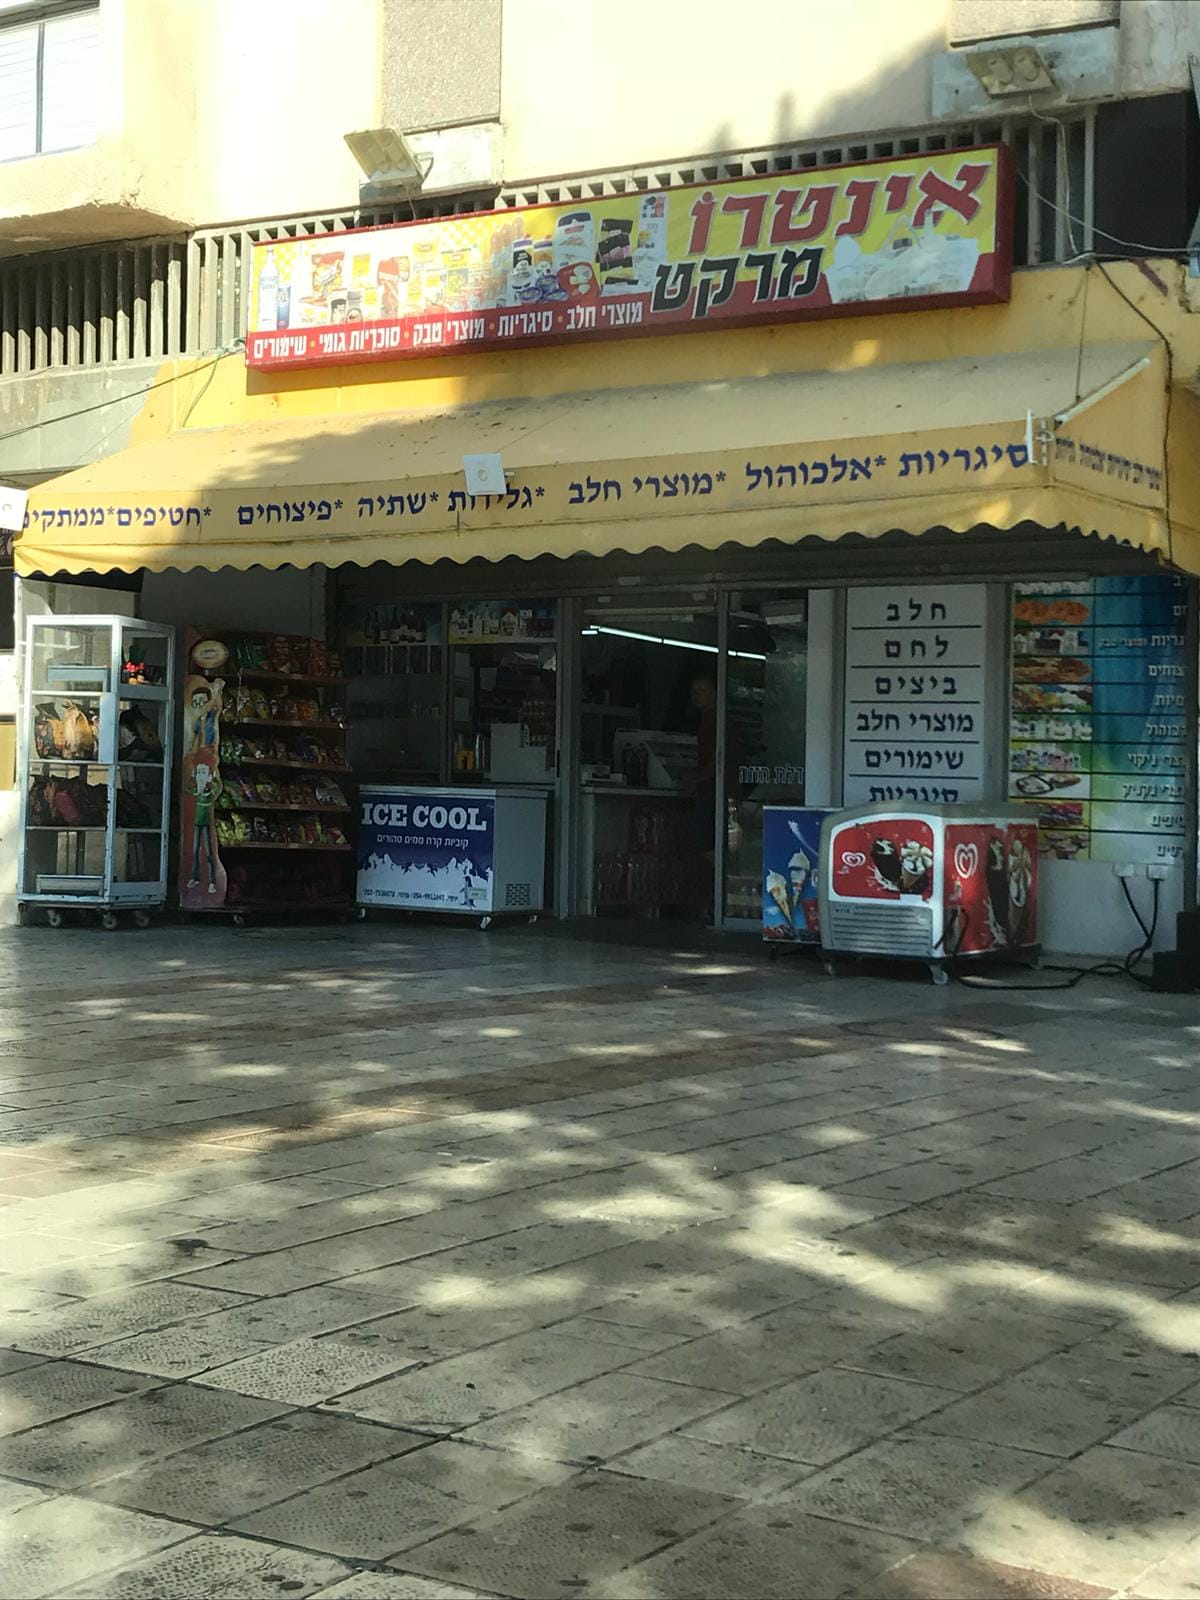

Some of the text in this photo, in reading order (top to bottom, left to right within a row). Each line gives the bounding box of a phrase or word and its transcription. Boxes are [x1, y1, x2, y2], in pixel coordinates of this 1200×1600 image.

[689, 163, 992, 255] אינטרו
[651, 246, 825, 319] מרקט
[254, 301, 643, 358] מוצרי חלב סיגריות מוצרי טבק סוכריות גומי שימורים
[632, 470, 712, 499] מוצרי
[744, 454, 873, 493] אלכוהול
[569, 475, 622, 504] חלב
[886, 597, 947, 622] חלב
[884, 634, 949, 658] לחם
[1151, 635, 1184, 647] גריות
[875, 675, 957, 695] ביצים
[856, 708, 974, 733] מוצרי חלב
[864, 749, 964, 770] שימורים
[361, 803, 487, 831] ICE COOL
